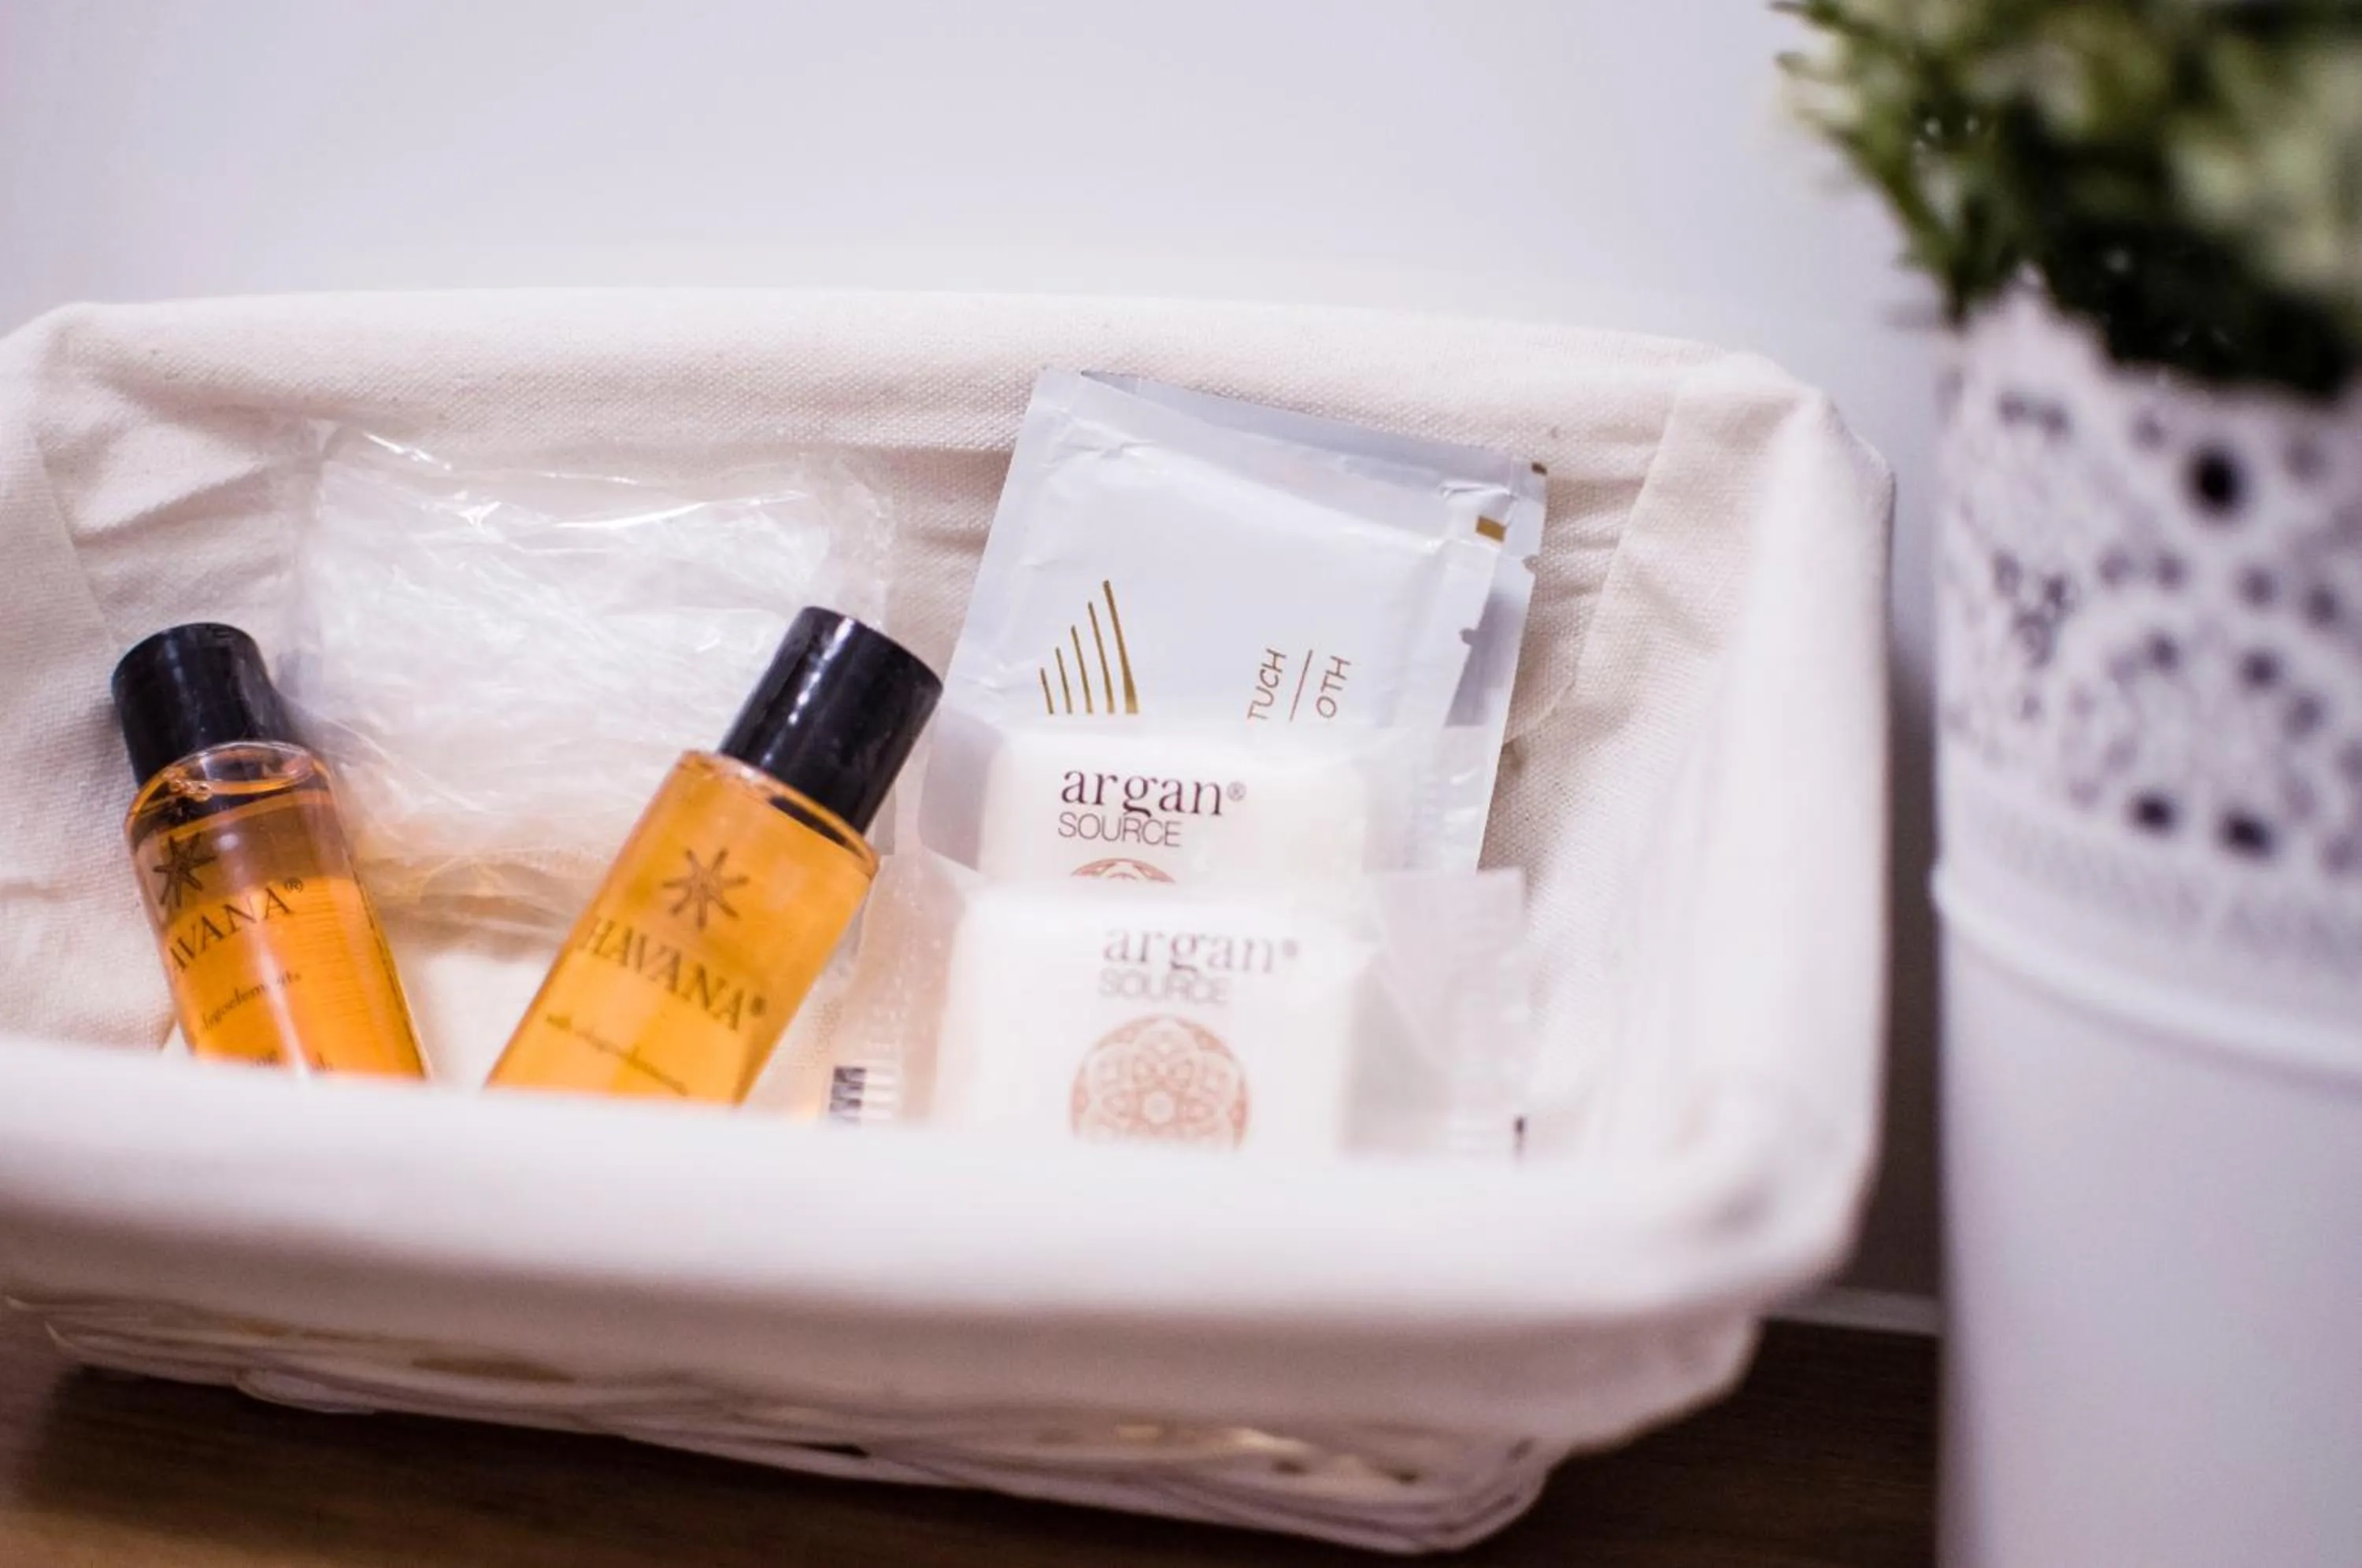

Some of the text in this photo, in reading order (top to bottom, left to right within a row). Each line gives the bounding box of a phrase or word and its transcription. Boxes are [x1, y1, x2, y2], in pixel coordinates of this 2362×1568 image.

[1247, 648, 1287, 719] TUCH
[1316, 655, 1352, 719] OTH
[1057, 811, 1183, 848] SOURCE
[1097, 967, 1231, 1004] SOURCE
